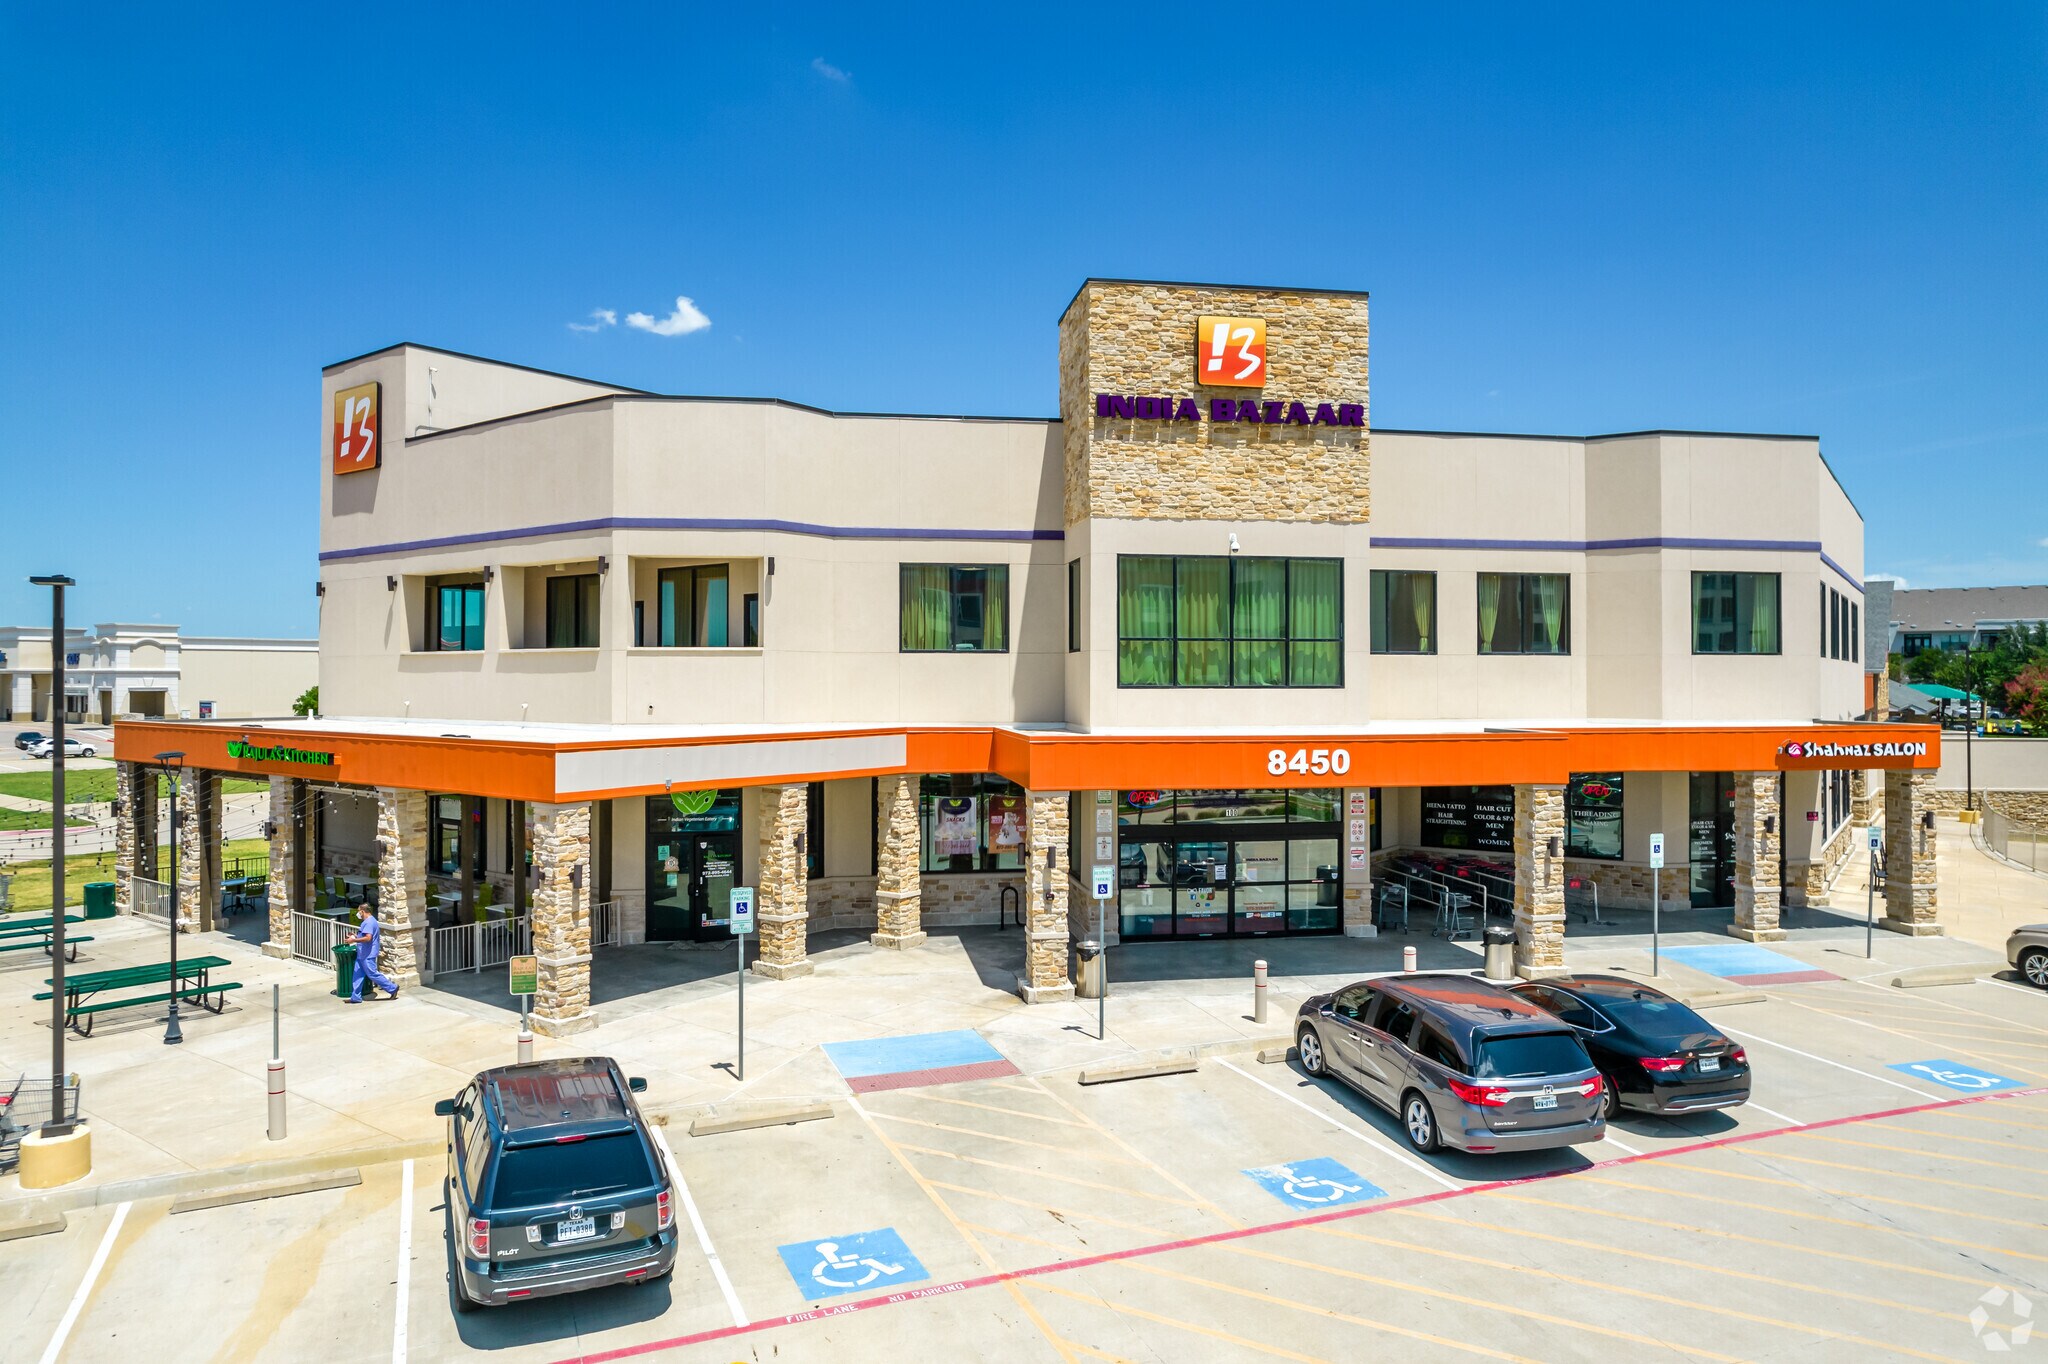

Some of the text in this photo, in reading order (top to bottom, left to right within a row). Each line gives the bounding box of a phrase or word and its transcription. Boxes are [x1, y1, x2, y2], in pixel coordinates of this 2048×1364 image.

[1096, 394, 1365, 427] INDIA BAZAAR
[1873, 743, 1926, 756] SALON
[284, 748, 329, 765] KITCHEN
[1267, 748, 1350, 775] 8450
[1582, 785, 1609, 796] OPEN
[1130, 791, 1159, 804] OPEN
[1426, 818, 1467, 826] STRAIGHTENING
[497, 1248, 519, 1256] PILOT
[785, 1283, 966, 1324] FIRE LANE NO PARKING
